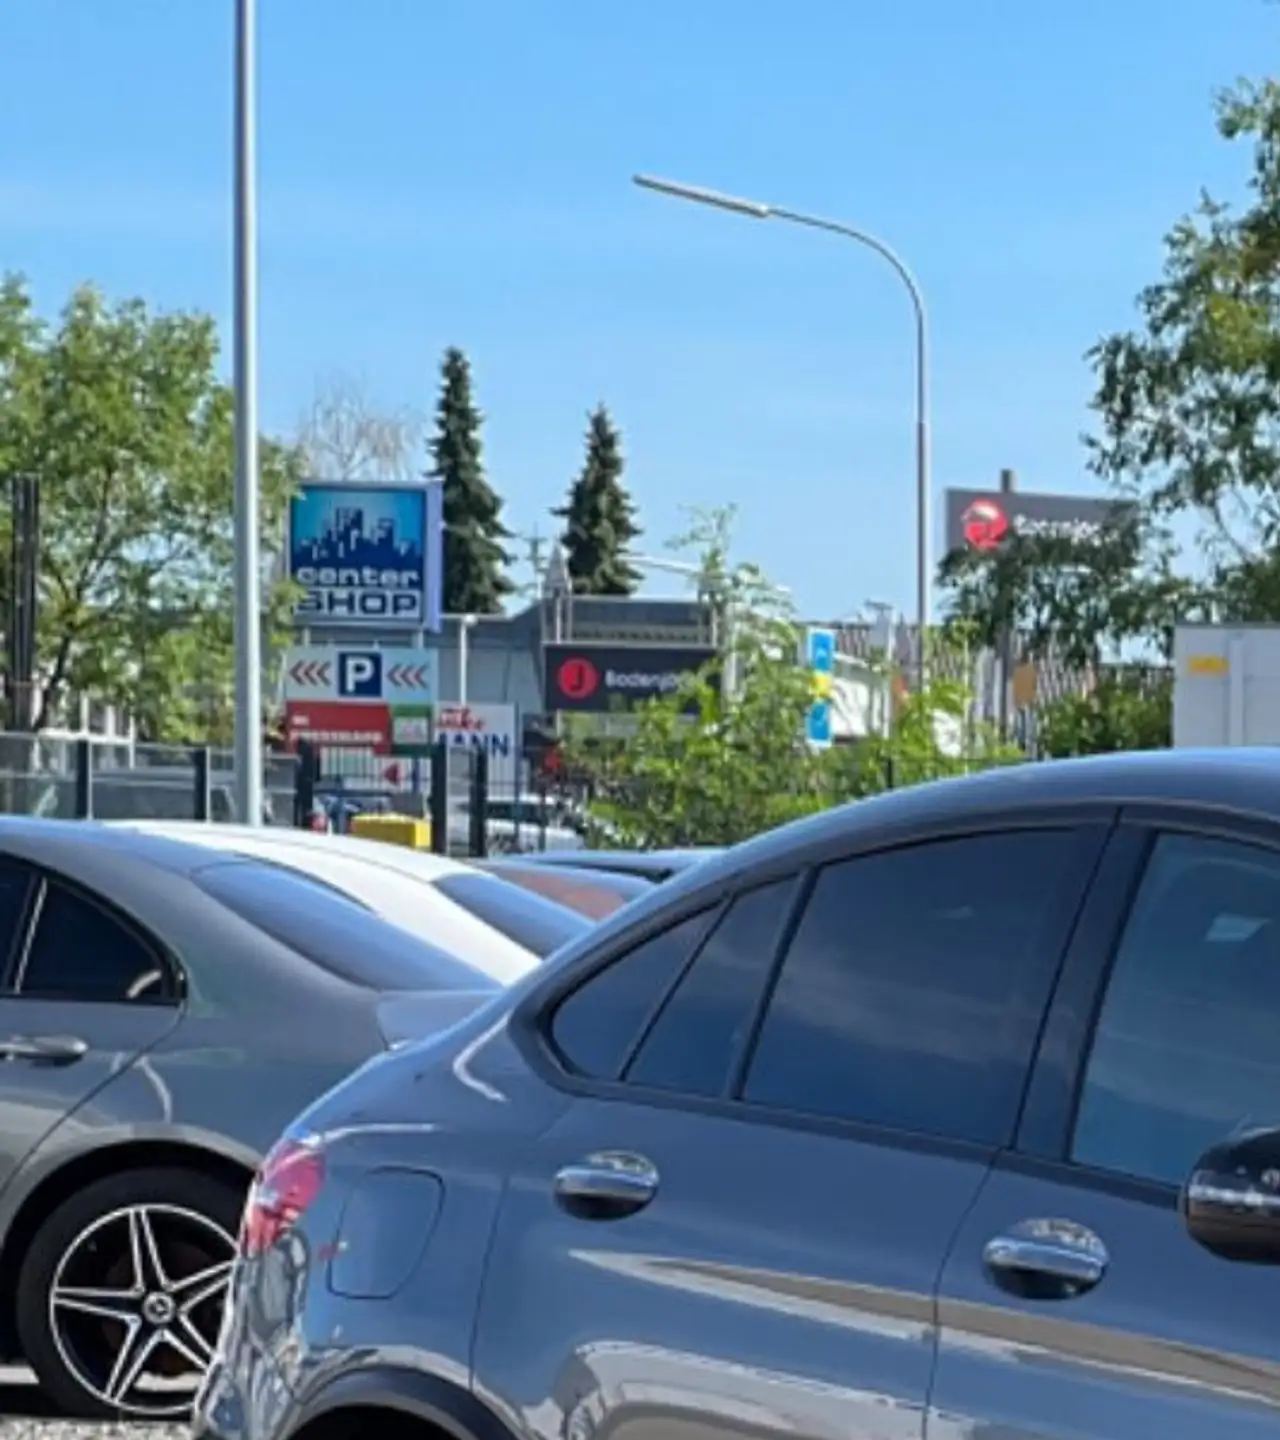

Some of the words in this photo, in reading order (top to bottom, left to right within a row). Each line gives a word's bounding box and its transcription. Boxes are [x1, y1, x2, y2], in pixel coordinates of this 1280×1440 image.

[297, 566, 420, 587] center
[298, 591, 417, 615] SHOP
[345, 656, 374, 693] P
